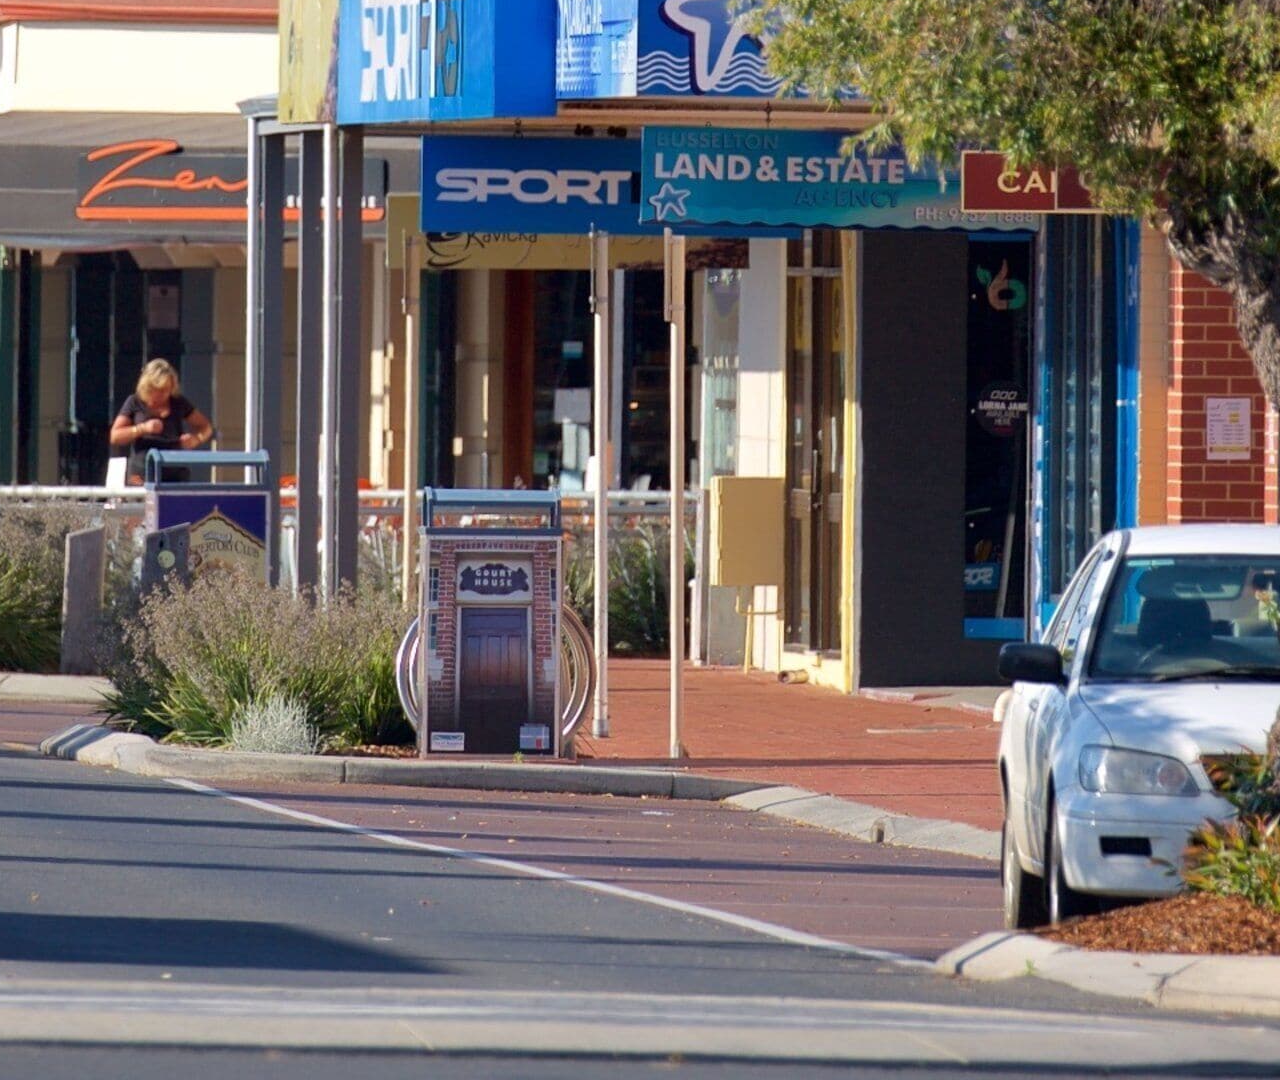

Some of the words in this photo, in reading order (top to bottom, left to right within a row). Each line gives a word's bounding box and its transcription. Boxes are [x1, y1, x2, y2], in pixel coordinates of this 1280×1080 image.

[655, 153, 751, 180] LAND
[756, 156, 780, 182] &
[786, 156, 905, 185] ESTATE
[475, 569, 513, 577] COURT
[475, 579, 513, 587] HOUSE
